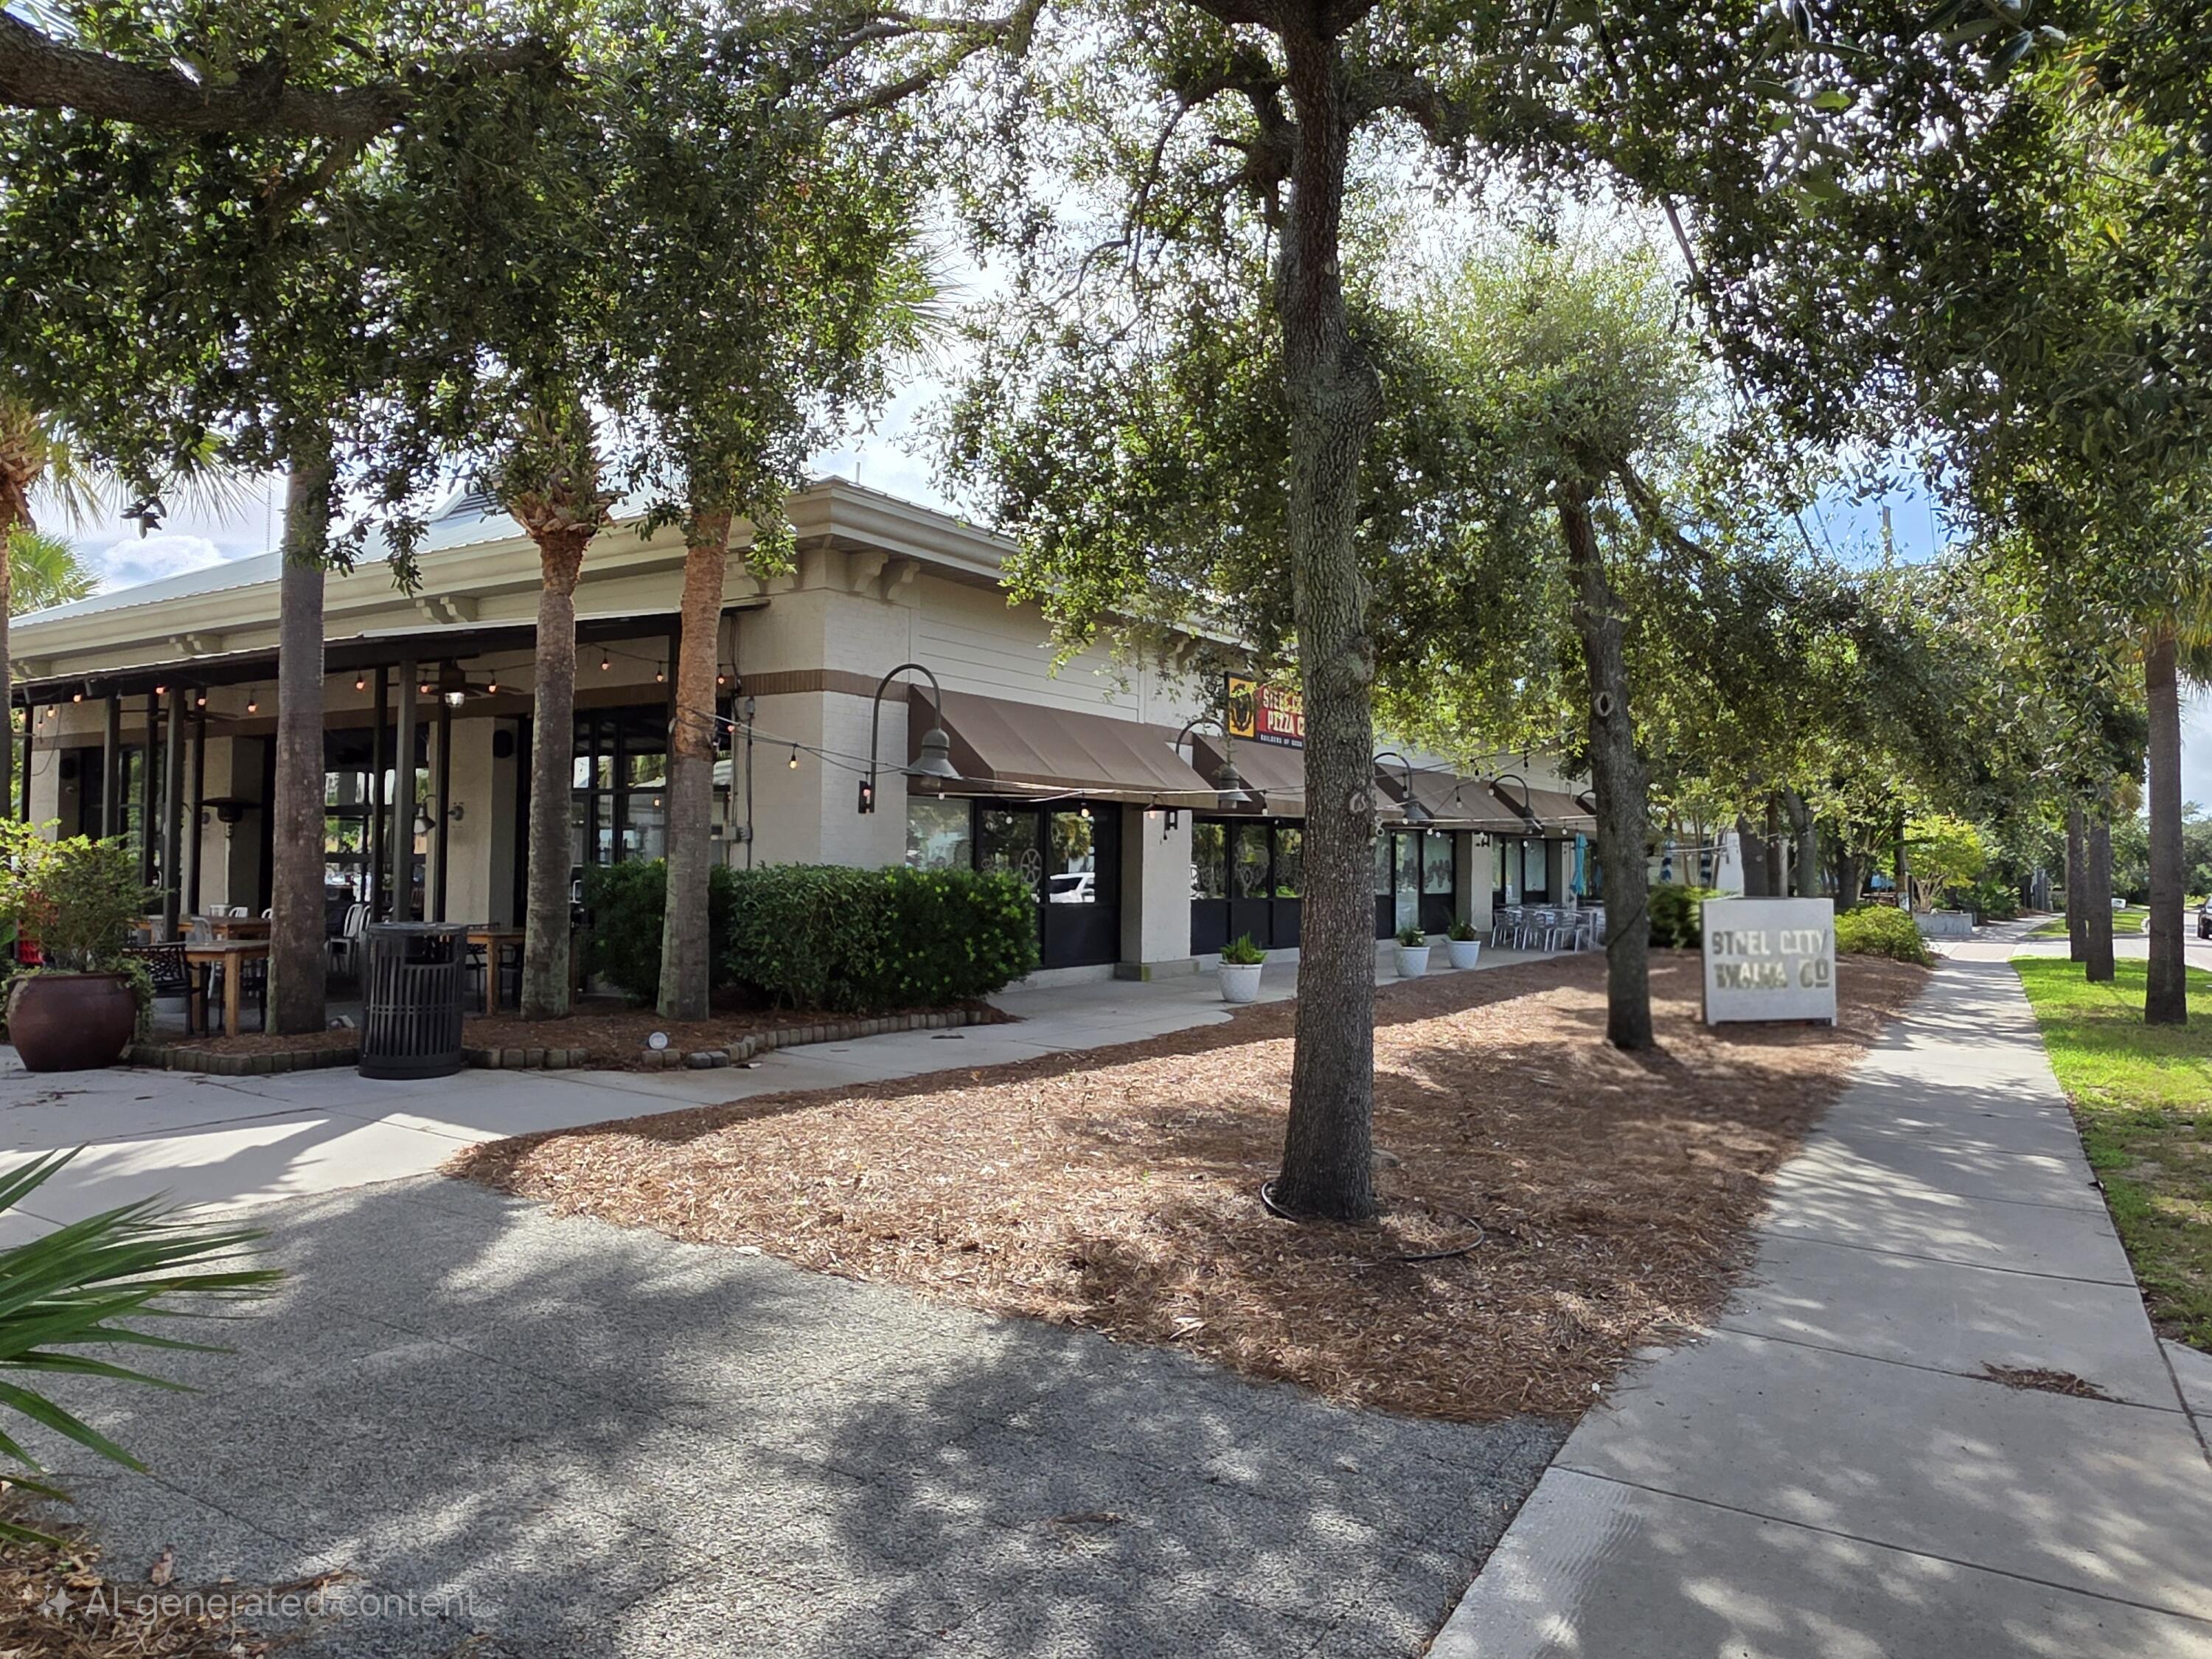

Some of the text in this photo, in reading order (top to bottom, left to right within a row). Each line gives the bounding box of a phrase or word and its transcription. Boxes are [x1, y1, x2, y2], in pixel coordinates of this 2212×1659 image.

[1267, 710, 1305, 737] PIZZA C
[1779, 928, 1828, 955] CITY
